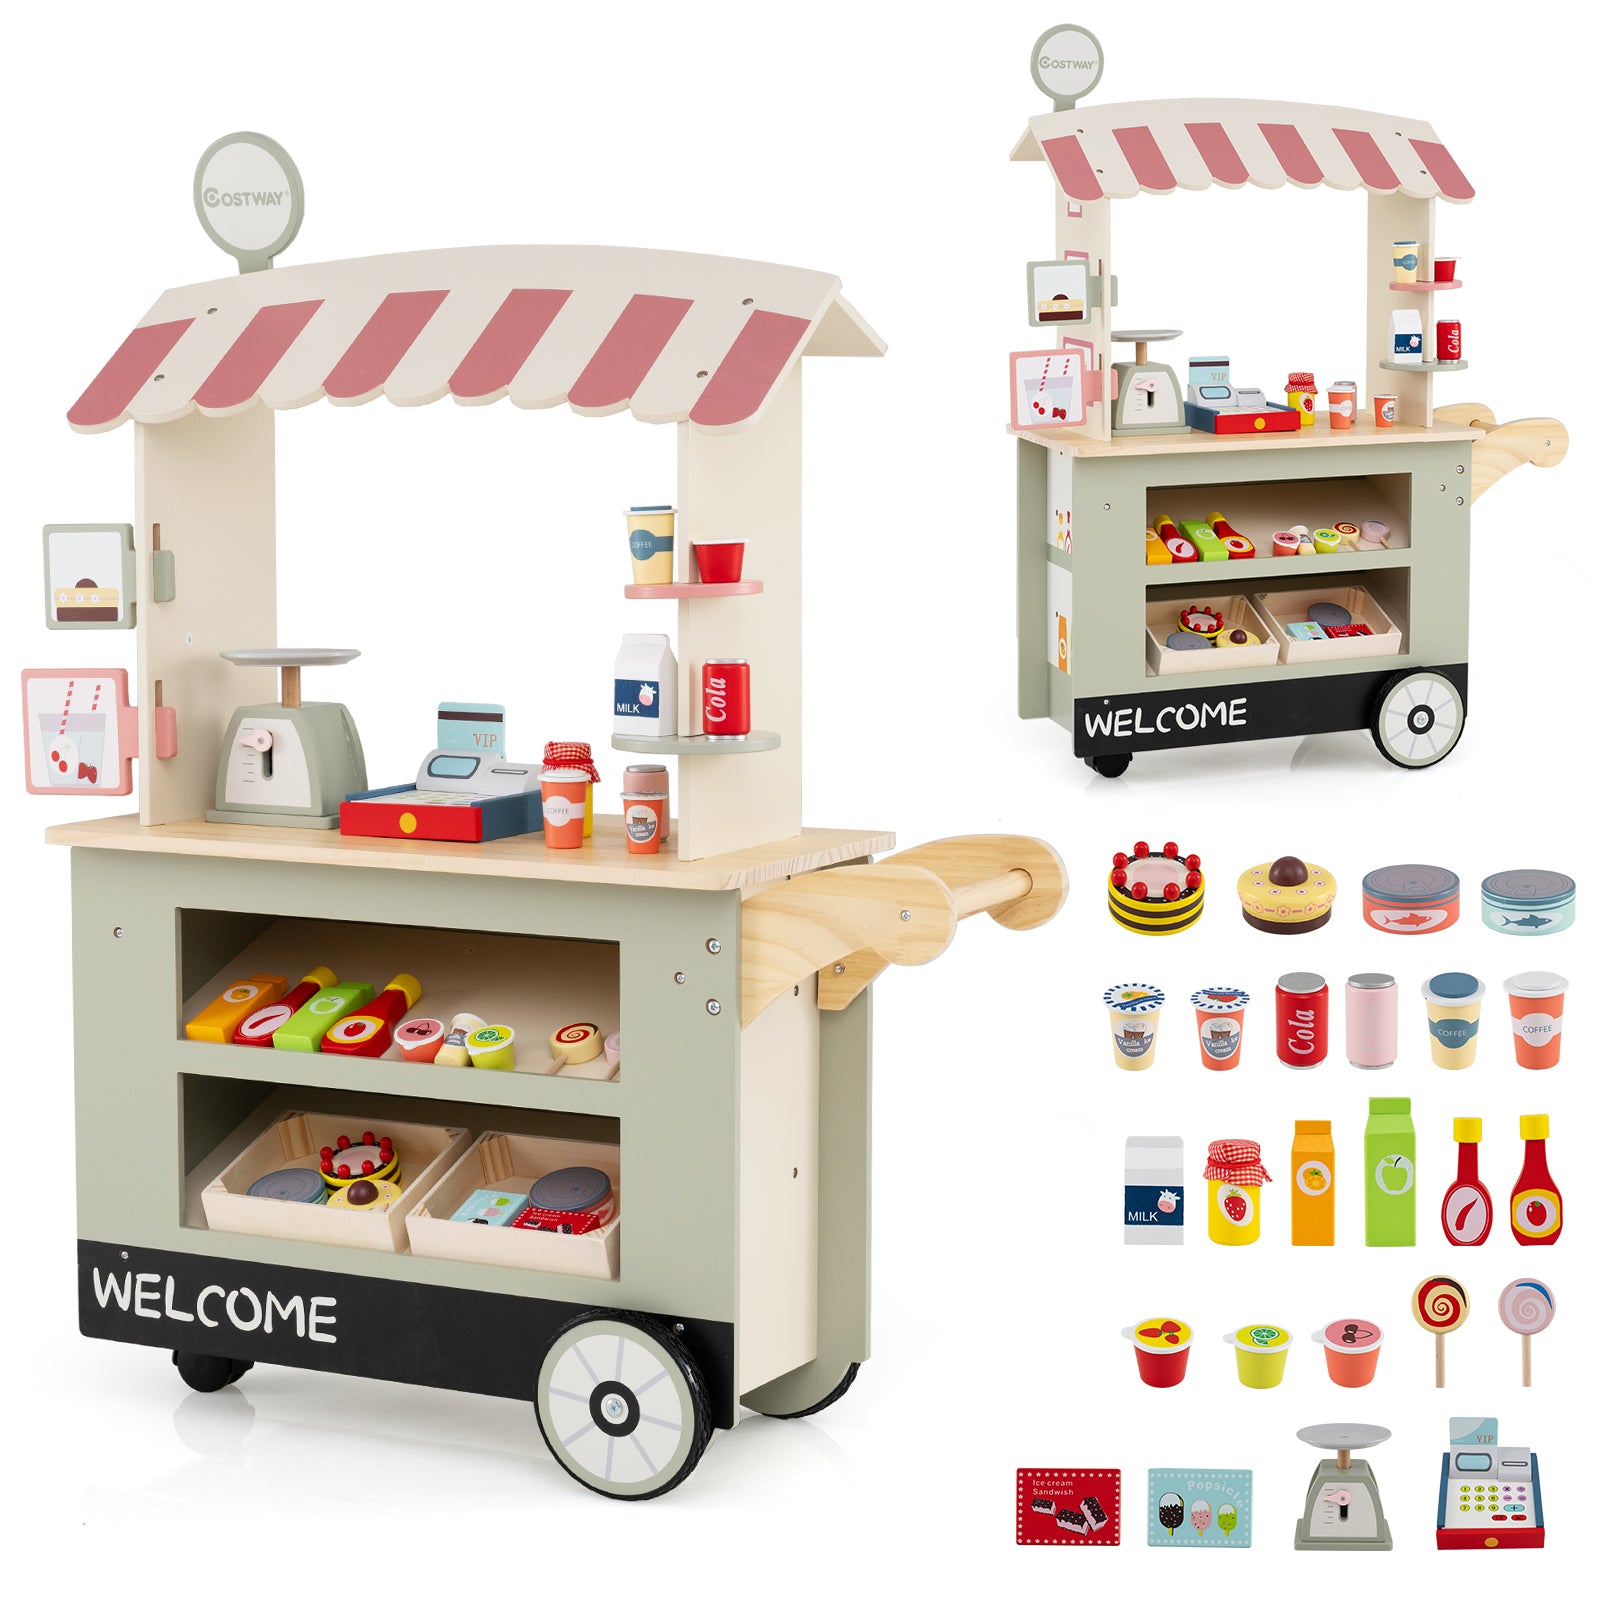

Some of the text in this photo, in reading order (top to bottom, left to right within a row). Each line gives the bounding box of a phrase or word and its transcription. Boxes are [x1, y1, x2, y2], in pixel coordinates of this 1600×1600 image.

[1039, 56, 1094, 70] COSTWAY
[203, 187, 284, 208] COSTWAY
[1448, 329, 1459, 353] Cola
[1210, 372, 1227, 381] VIP
[706, 677, 727, 723] Cola
[616, 703, 640, 714] MILK
[1085, 697, 1247, 737] WELCOME
[472, 733, 498, 748] VIP
[1287, 1009, 1315, 1055] Cola
[1437, 1028, 1467, 1037] COFFEE
[1522, 1024, 1553, 1034] COFFEE
[1117, 1037, 1140, 1047] Vanilla
[1205, 1039, 1228, 1048] Vanilla
[1128, 1211, 1158, 1222] MILK
[93, 1267, 337, 1343] WELCOME
[1476, 1434, 1494, 1444] VIP
[1032, 1479, 1045, 1487] Ice
[1032, 1488, 1074, 1496] Sandwish
[1187, 1480, 1244, 1508] Popsicle
